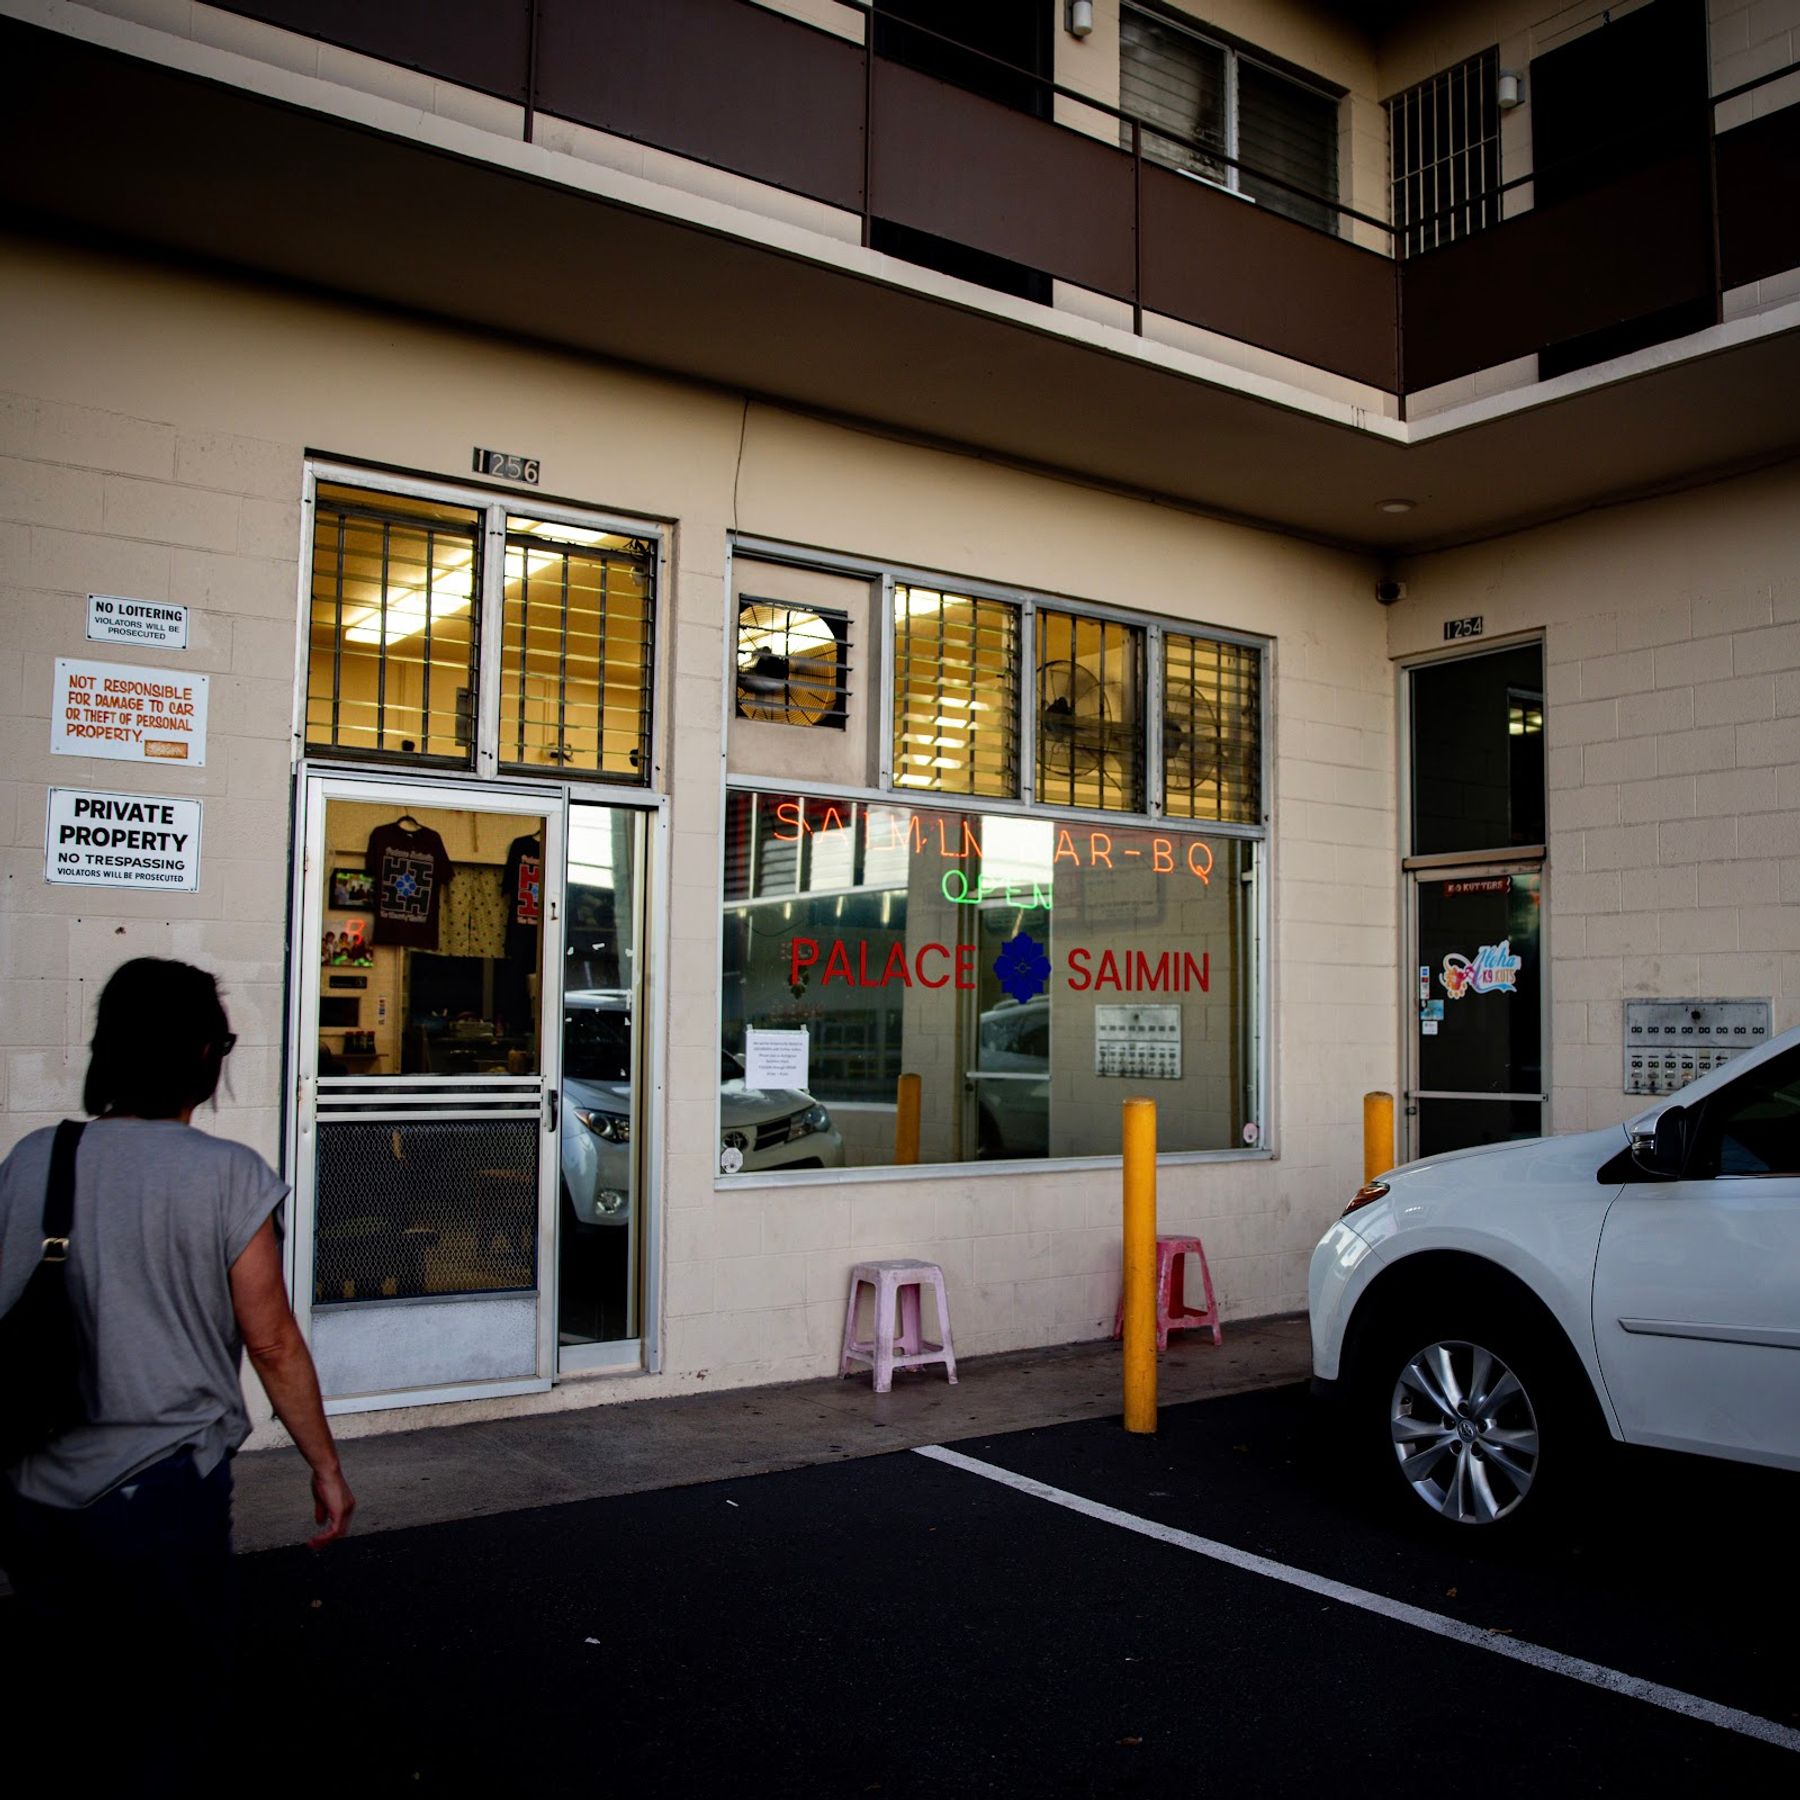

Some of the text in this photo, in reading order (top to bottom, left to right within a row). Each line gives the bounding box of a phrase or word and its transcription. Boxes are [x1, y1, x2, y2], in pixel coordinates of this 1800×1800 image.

[478, 449, 538, 484] 1256
[95, 601, 182, 621] NO LOITERING
[94, 616, 180, 633] VIOLATORS WILL BE
[108, 627, 166, 640] PROSECUTED
[1446, 617, 1482, 639] 1254
[69, 675, 193, 700] NOT RESPONSIBLE
[68, 691, 194, 716] FOR DAMAGE TO CAR
[65, 707, 193, 732] OR THEFT OF PERSONAL
[66, 723, 143, 743] PROPERTY.
[74, 798, 175, 825] PRIVATE
[59, 824, 188, 852] PROPERTY
[58, 852, 185, 870] NO TRESPASSING
[1053, 829, 1214, 886] AR-BQ
[57, 867, 184, 883] VIOLATORS WILL BE PROSECUTED
[941, 868, 1053, 910] OPEN
[790, 936, 1210, 993] PALACE SAIMIN
